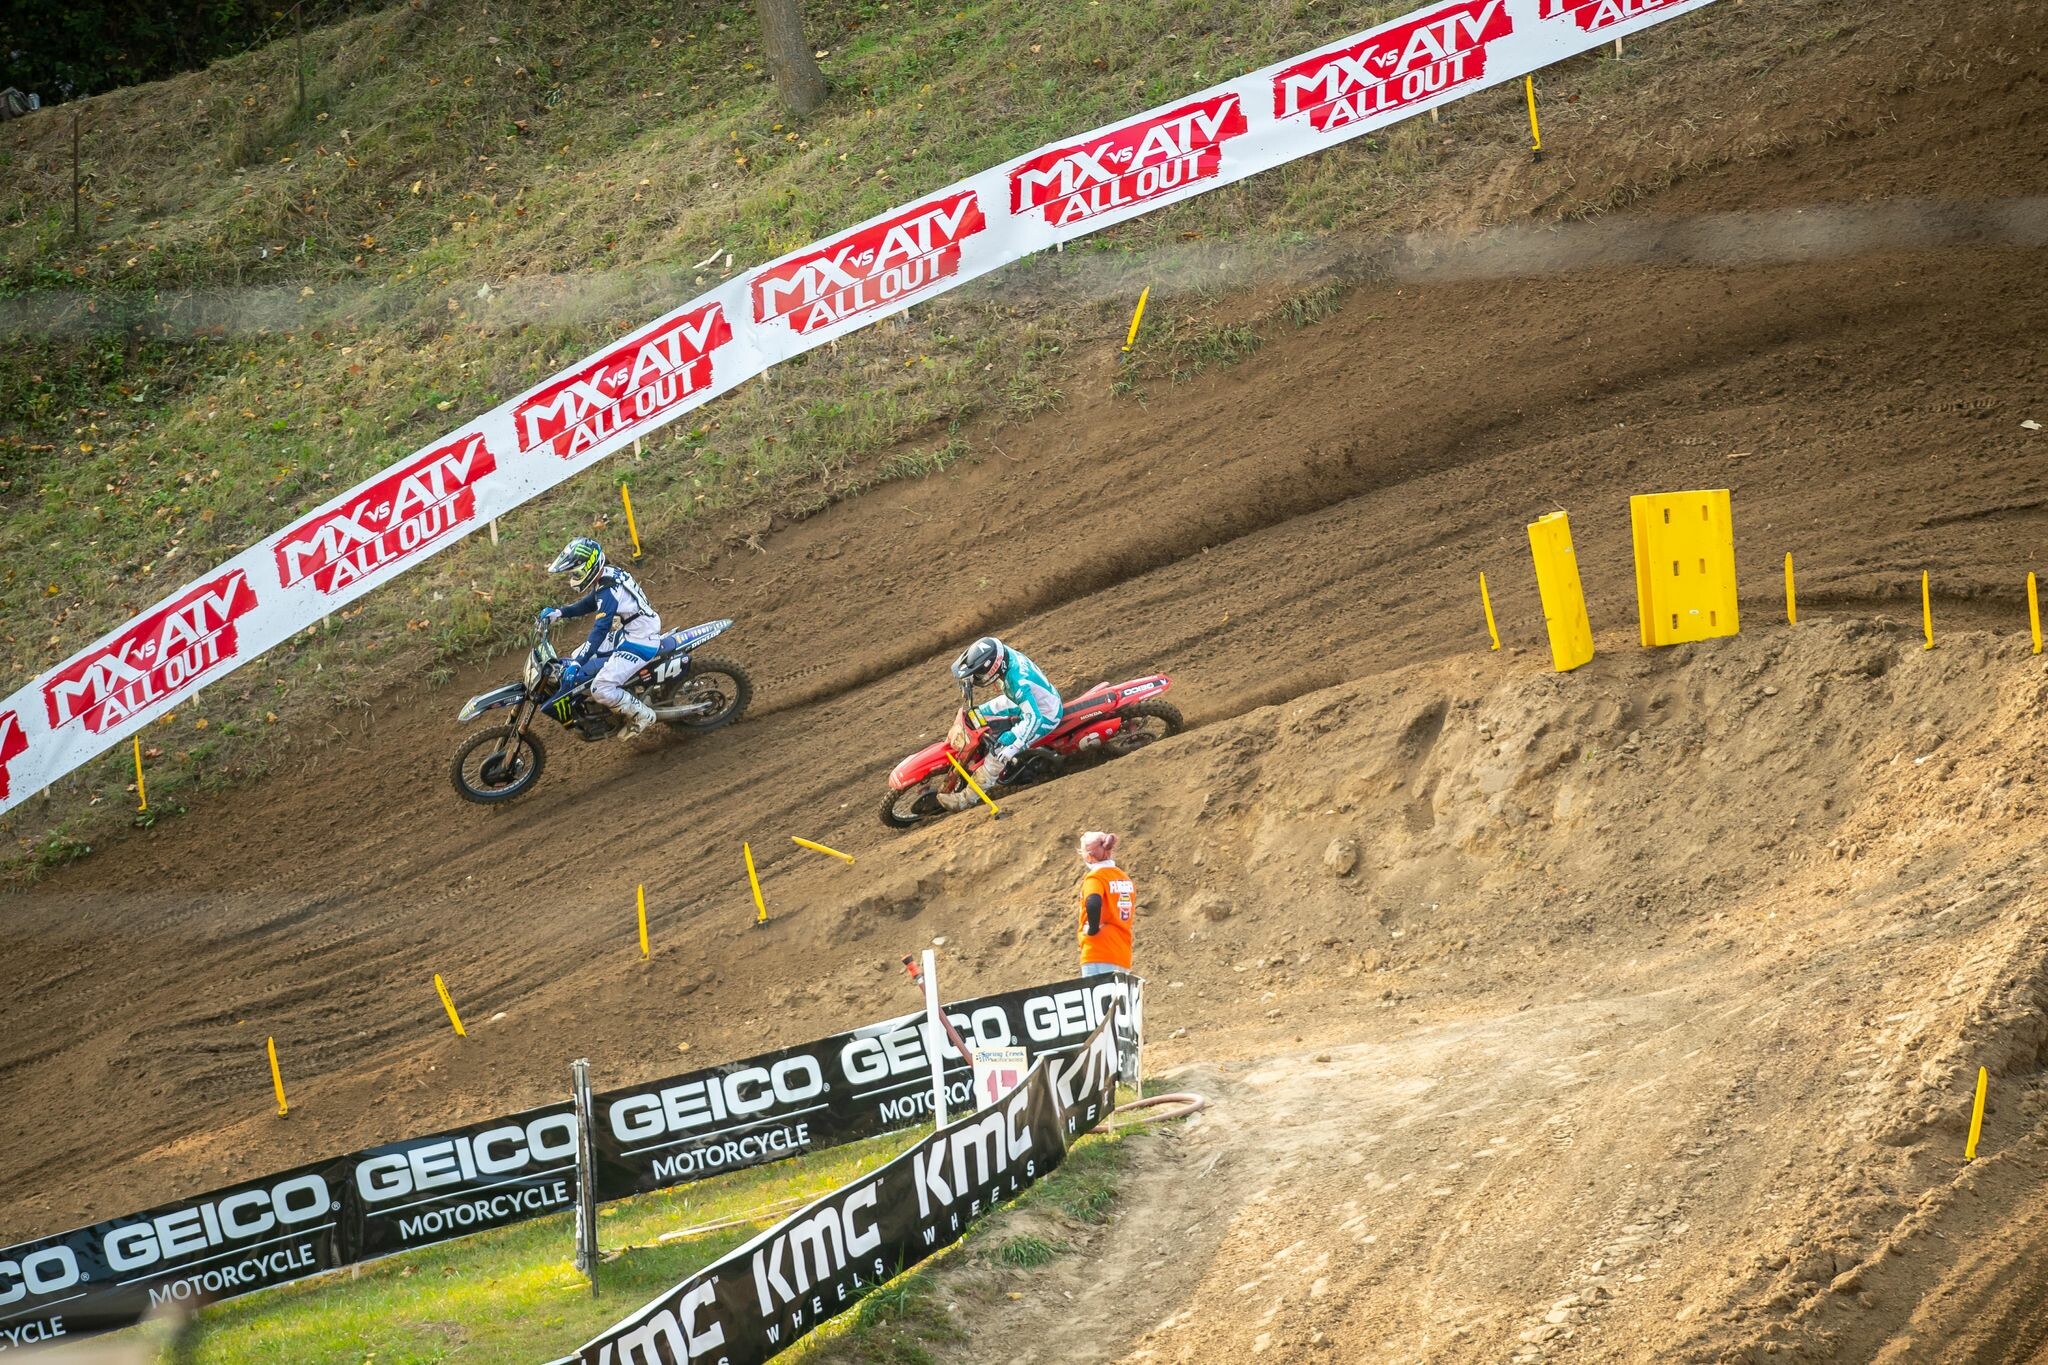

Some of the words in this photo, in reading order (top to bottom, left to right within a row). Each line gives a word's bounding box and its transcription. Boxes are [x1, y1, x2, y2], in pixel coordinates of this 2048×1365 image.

[1281, 44, 1383, 118] MX
[1393, 0, 1500, 75] ATV
[1321, 82, 1398, 131] ALL
[1402, 50, 1471, 100] OUT
[1017, 142, 1118, 213] MX
[1126, 97, 1239, 171] ATV
[1055, 177, 1132, 226] ALL
[1136, 149, 1206, 197] OUT
[759, 245, 859, 323] MX
[867, 193, 977, 277] ATV
[801, 281, 876, 333] ALL
[880, 248, 946, 299] OUT
[521, 366, 617, 451] MX
[624, 305, 722, 395] ATV
[567, 400, 634, 458] ALL
[635, 362, 697, 417] OUT
[282, 499, 378, 587] MX
[386, 436, 484, 529] ATV
[327, 534, 398, 593] ALL
[400, 492, 460, 550] OUT
[51, 638, 146, 729] MX
[152, 572, 245, 668] ATV
[100, 674, 164, 730] ALL
[165, 630, 222, 688] OUT
[654, 656, 682, 683] 14
[1080, 710, 1103, 721] HONDA
[355, 1113, 577, 1202] GEICO
[652, 1123, 811, 1180] MOTORCYCLE
[399, 1181, 569, 1240] MOTORCYCLE
[923, 1160, 1035, 1245] WHEELS
[148, 1243, 315, 1309] MOTORCYCLE
[766, 1258, 884, 1345] WHEELS
[0, 1315, 67, 1351] YCLE
